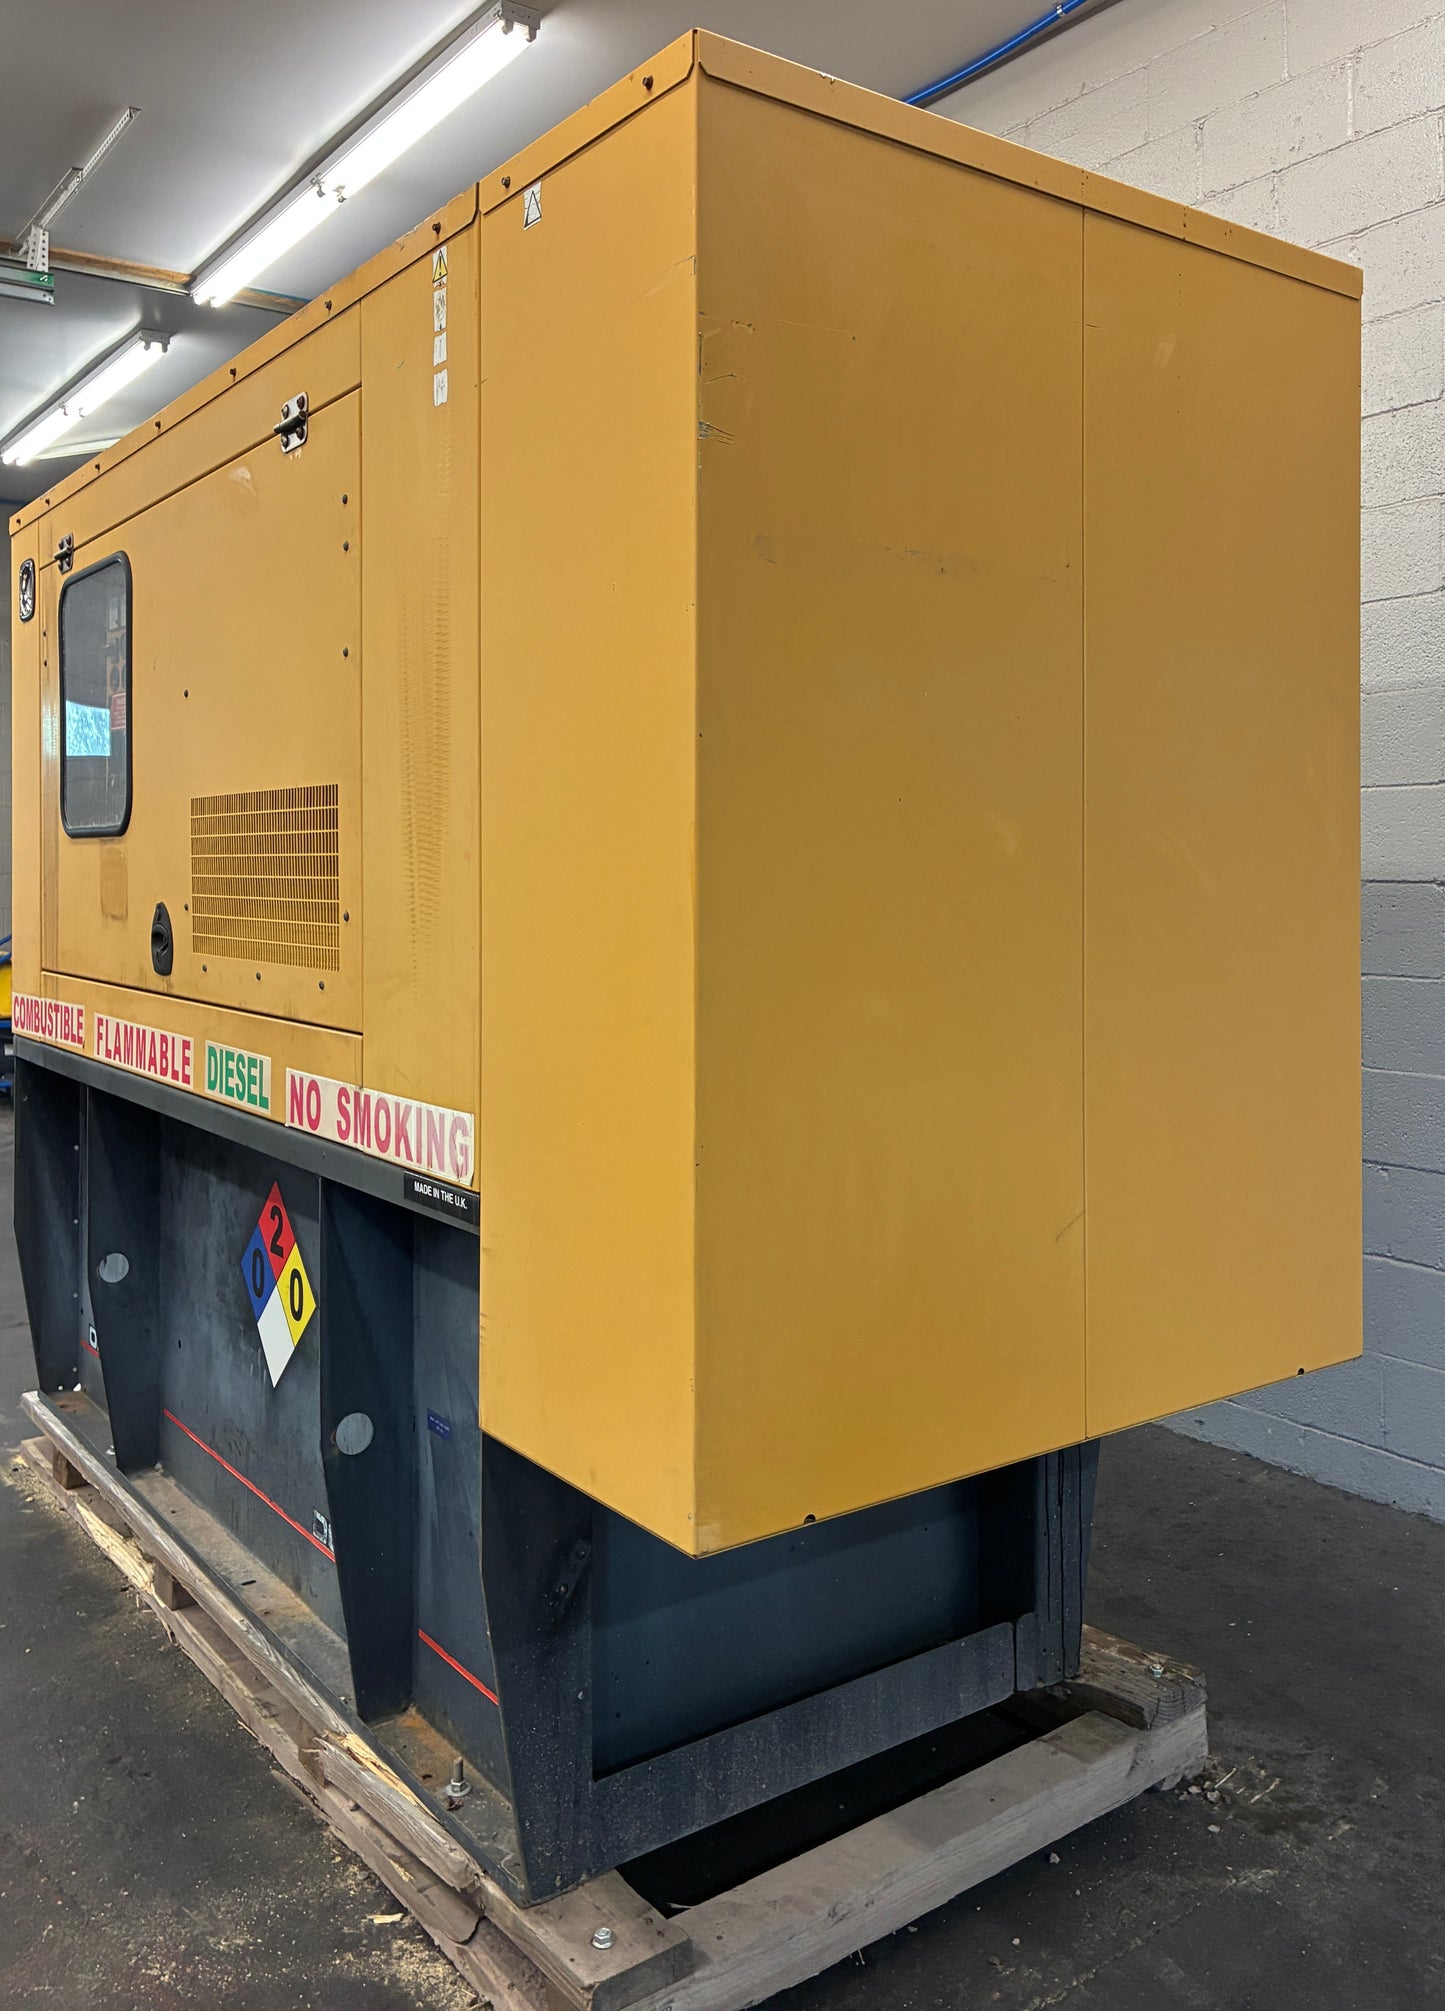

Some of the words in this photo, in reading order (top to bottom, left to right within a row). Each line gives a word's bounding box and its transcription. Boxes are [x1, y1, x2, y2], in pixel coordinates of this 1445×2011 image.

[14, 995, 83, 1045] COMBUSTIBLE
[97, 1016, 191, 1086] FLAMMABLE
[208, 1046, 269, 1110] DIESEL
[290, 1074, 321, 1131] NO
[336, 1086, 470, 1179] SMOKING
[414, 1181, 432, 1197] MADE
[433, 1187, 440, 1199] IN
[441, 1190, 454, 1205] THE
[270, 1205, 284, 1258] 2
[252, 1247, 264, 1298] 0
[290, 1268, 303, 1322] 0
